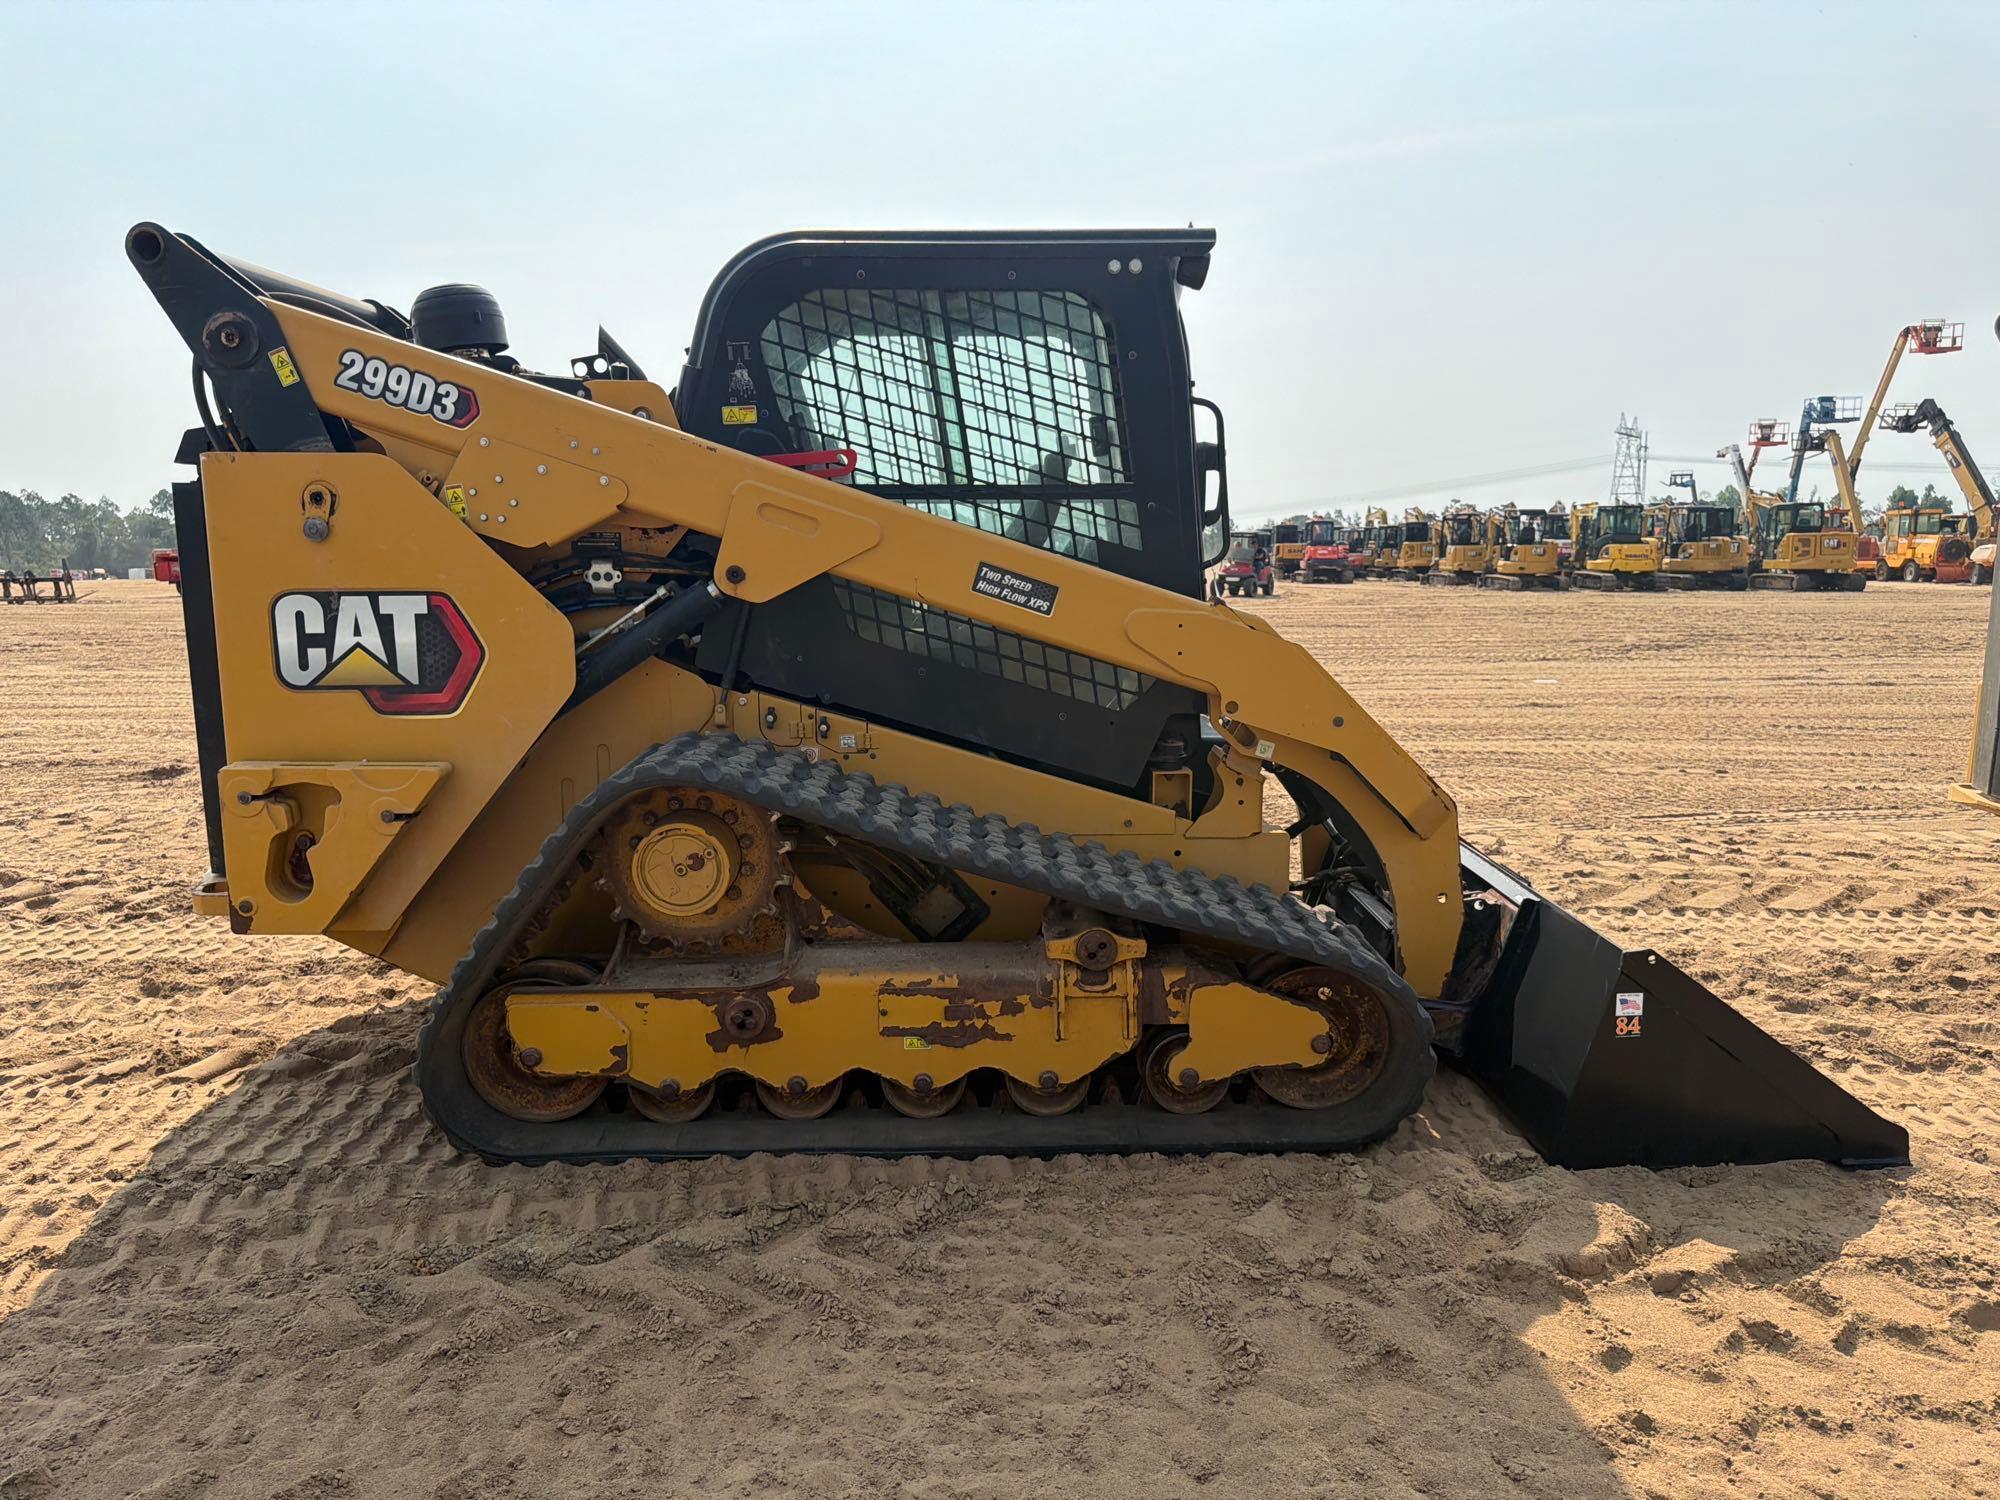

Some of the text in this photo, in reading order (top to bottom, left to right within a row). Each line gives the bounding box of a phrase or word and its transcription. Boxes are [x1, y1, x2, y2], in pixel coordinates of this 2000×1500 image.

[336, 351, 459, 421] 299D3
[1824, 539, 1838, 548] CAT
[1027, 597, 1050, 612] XPS
[275, 594, 428, 687] CAT
[1615, 1016, 1641, 1035] 84
